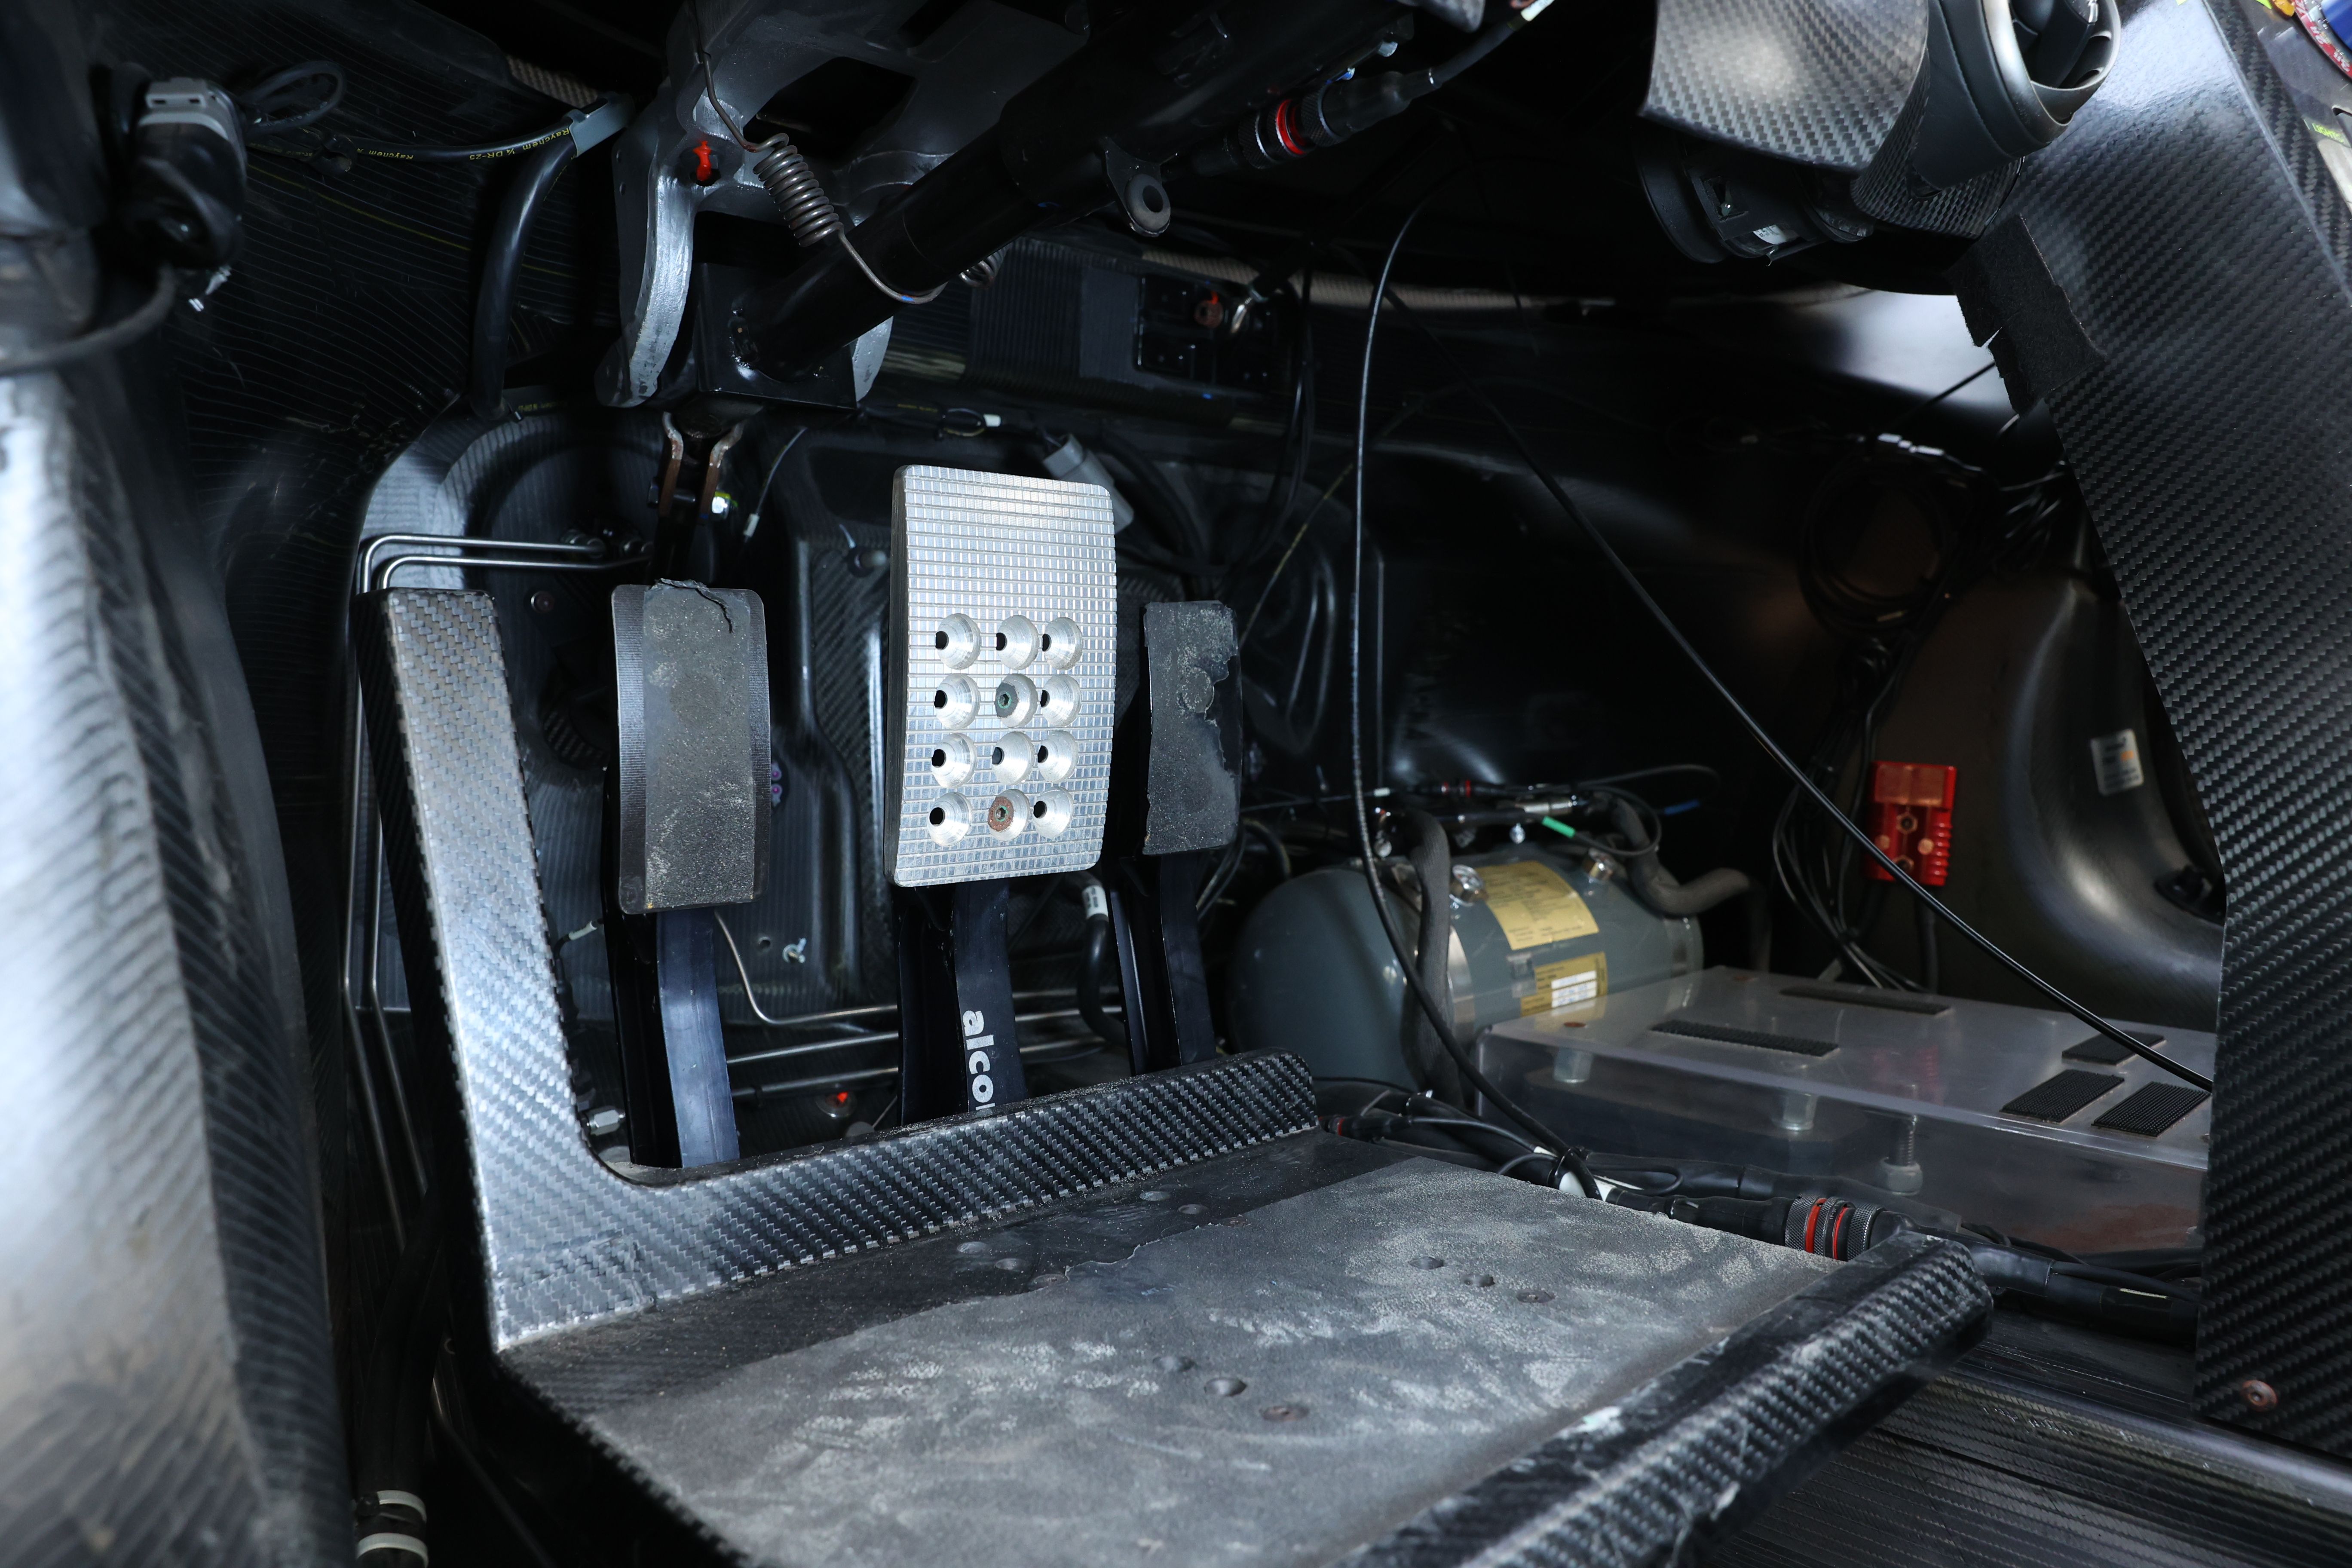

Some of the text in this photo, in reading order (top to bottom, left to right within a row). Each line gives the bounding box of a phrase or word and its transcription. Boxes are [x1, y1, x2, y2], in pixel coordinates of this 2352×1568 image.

[522, 128, 570, 150] Raychem
[368, 150, 414, 160] Raychem
[469, 150, 503, 161] DR-25
